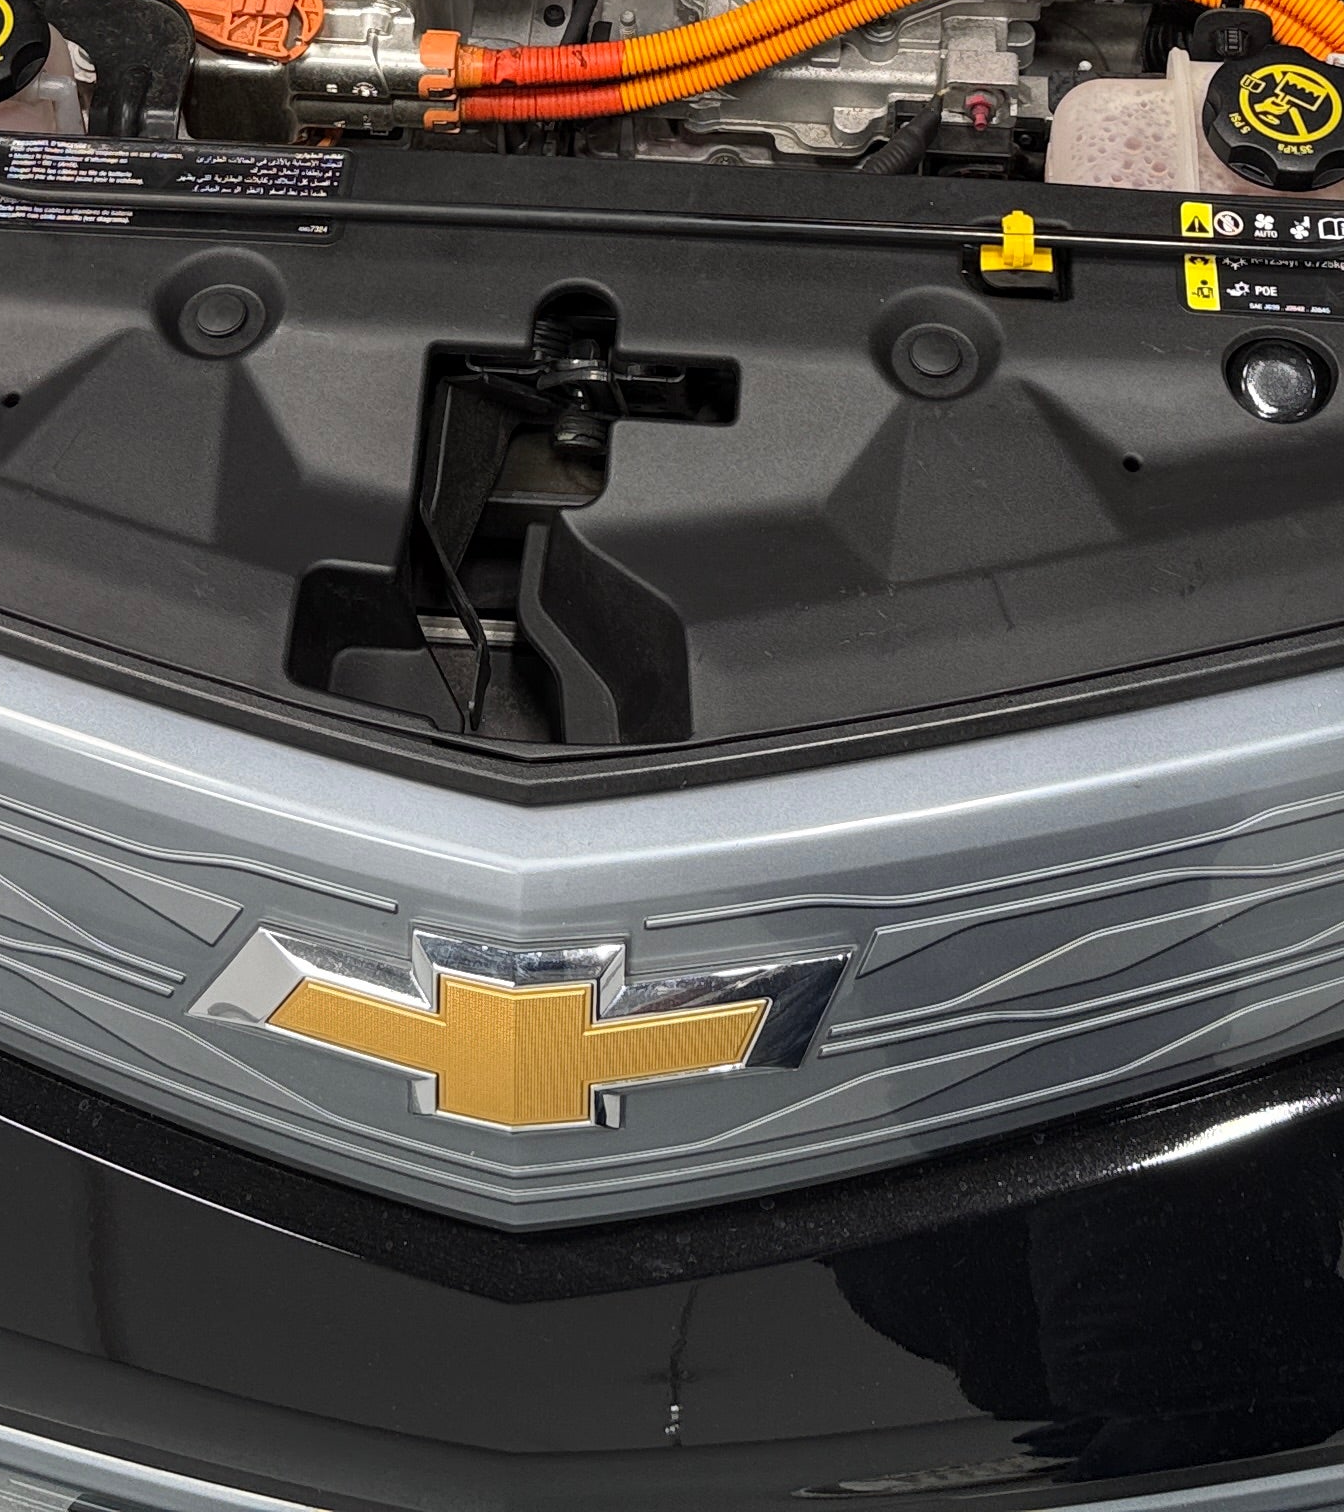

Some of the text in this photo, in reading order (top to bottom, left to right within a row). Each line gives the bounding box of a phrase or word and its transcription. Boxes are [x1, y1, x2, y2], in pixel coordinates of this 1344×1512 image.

[1228, 112, 1251, 135] 5 PSI
[1277, 143, 1315, 155] 35 kPa
[1254, 229, 1278, 238] AUTO
[1255, 286, 1278, 297] POE
